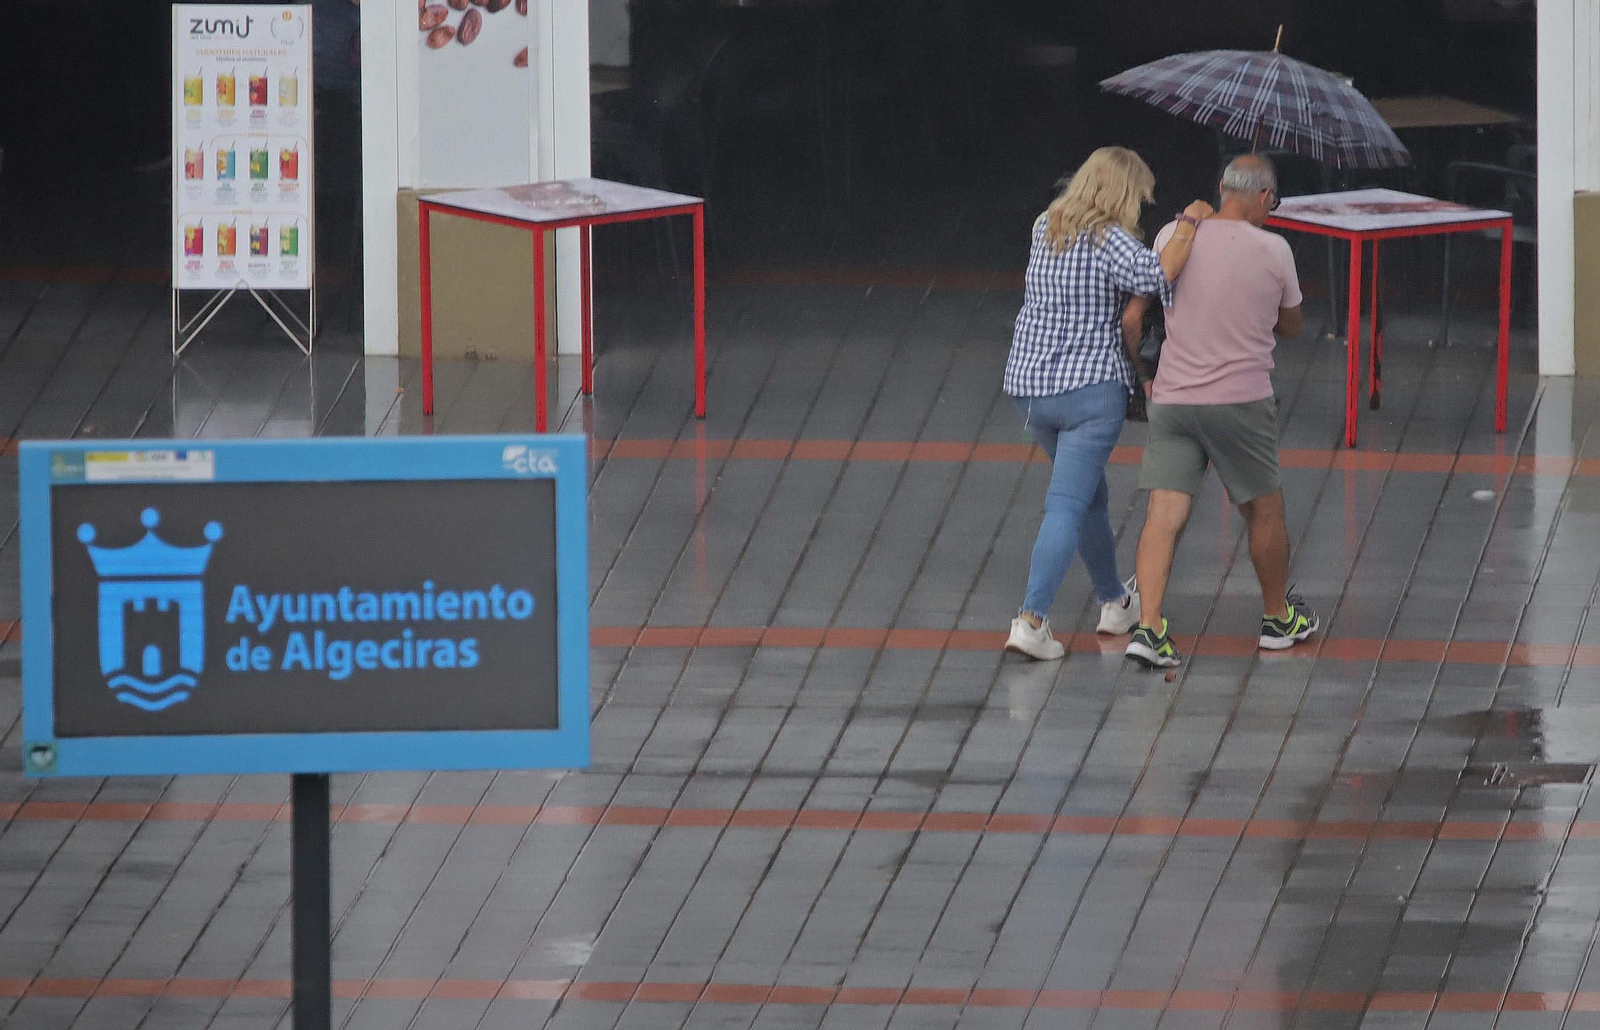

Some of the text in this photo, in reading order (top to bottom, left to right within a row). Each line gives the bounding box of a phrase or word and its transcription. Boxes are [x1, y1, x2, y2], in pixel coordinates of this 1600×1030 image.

[190, 15, 253, 38] zumit
[513, 449, 557, 473] cta
[226, 581, 535, 632] Ayuntamiento
[226, 629, 480, 680] de Algeciras
